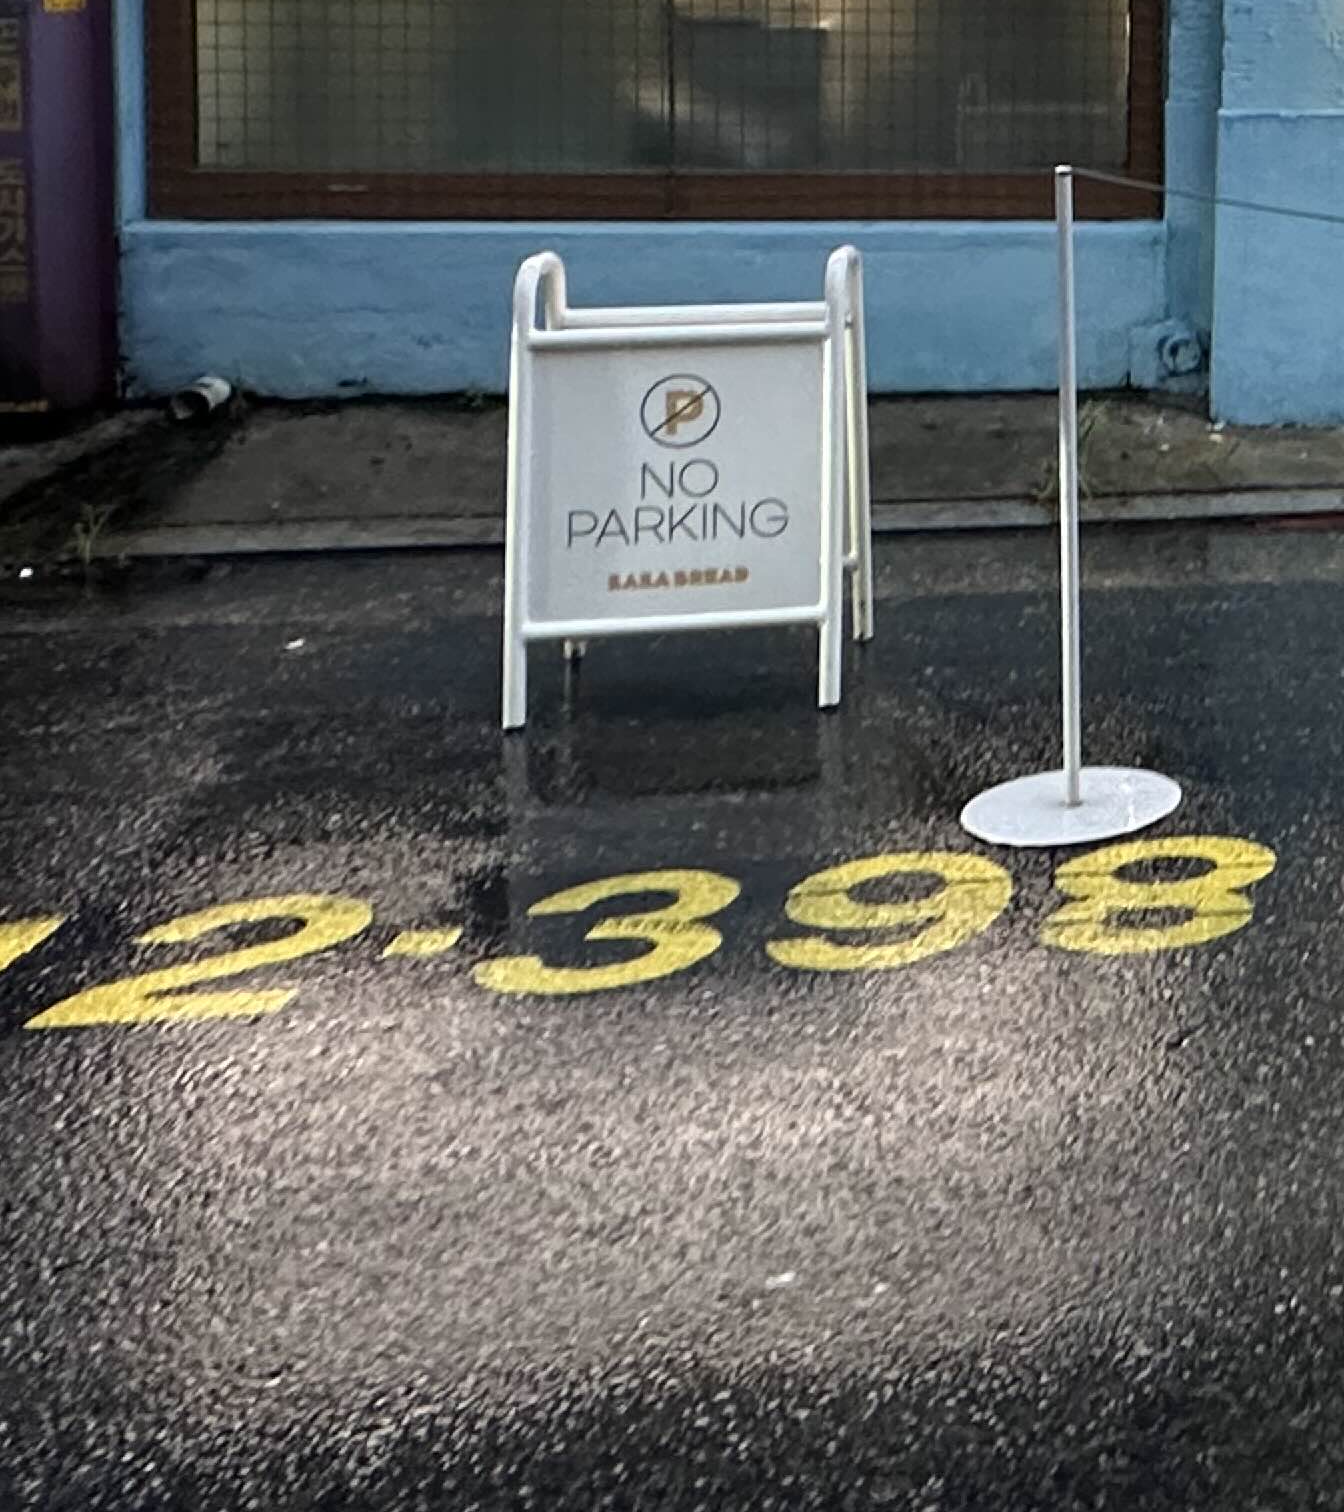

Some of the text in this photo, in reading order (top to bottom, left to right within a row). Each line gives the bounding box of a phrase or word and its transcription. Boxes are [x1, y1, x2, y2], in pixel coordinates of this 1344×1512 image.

[640, 458, 719, 500] NO
[567, 497, 790, 549] PARKING
[0, 836, 1277, 1029] 2-398
